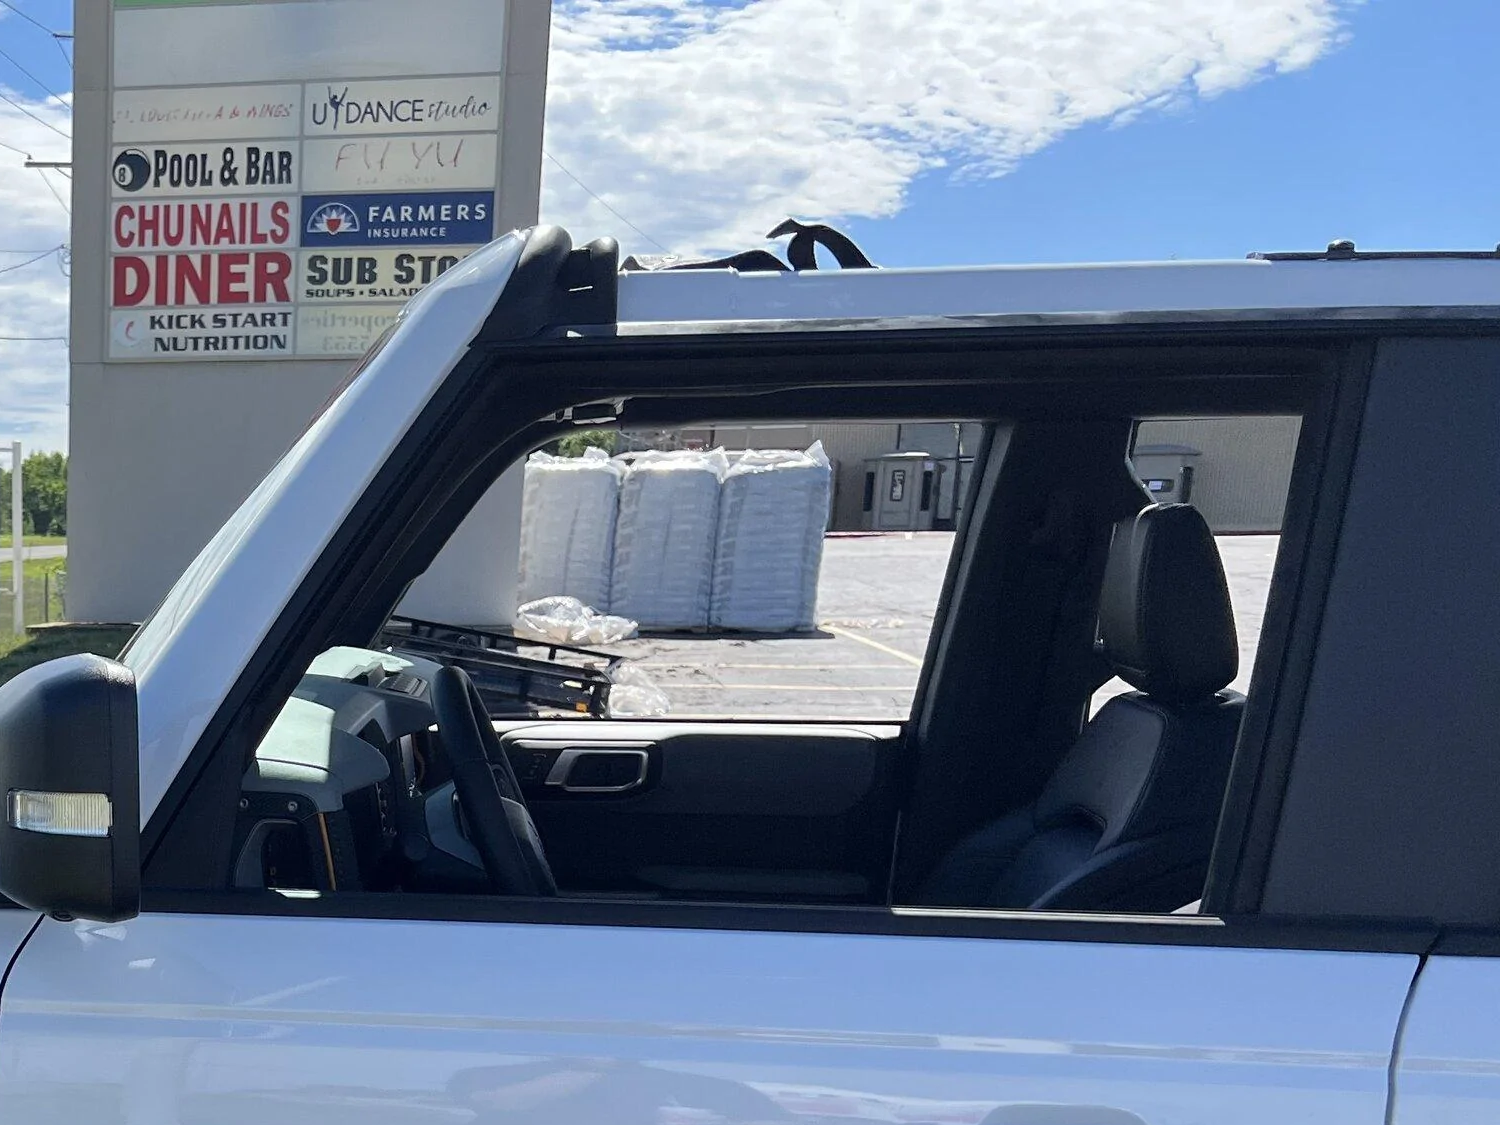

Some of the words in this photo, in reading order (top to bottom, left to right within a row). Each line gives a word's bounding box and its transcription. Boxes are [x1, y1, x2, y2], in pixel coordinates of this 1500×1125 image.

[428, 95, 491, 122] studio
[220, 146, 239, 187] &
[368, 204, 486, 222] FARMERS
[115, 201, 290, 248] CHUNAILS
[367, 227, 447, 238] INSURANCE
[113, 252, 292, 307] DINER
[307, 255, 377, 285] SUB
[305, 289, 355, 299] SOUPS
[150, 314, 206, 330] KICK
[212, 312, 292, 329] START
[154, 334, 287, 351] NUTRITION
